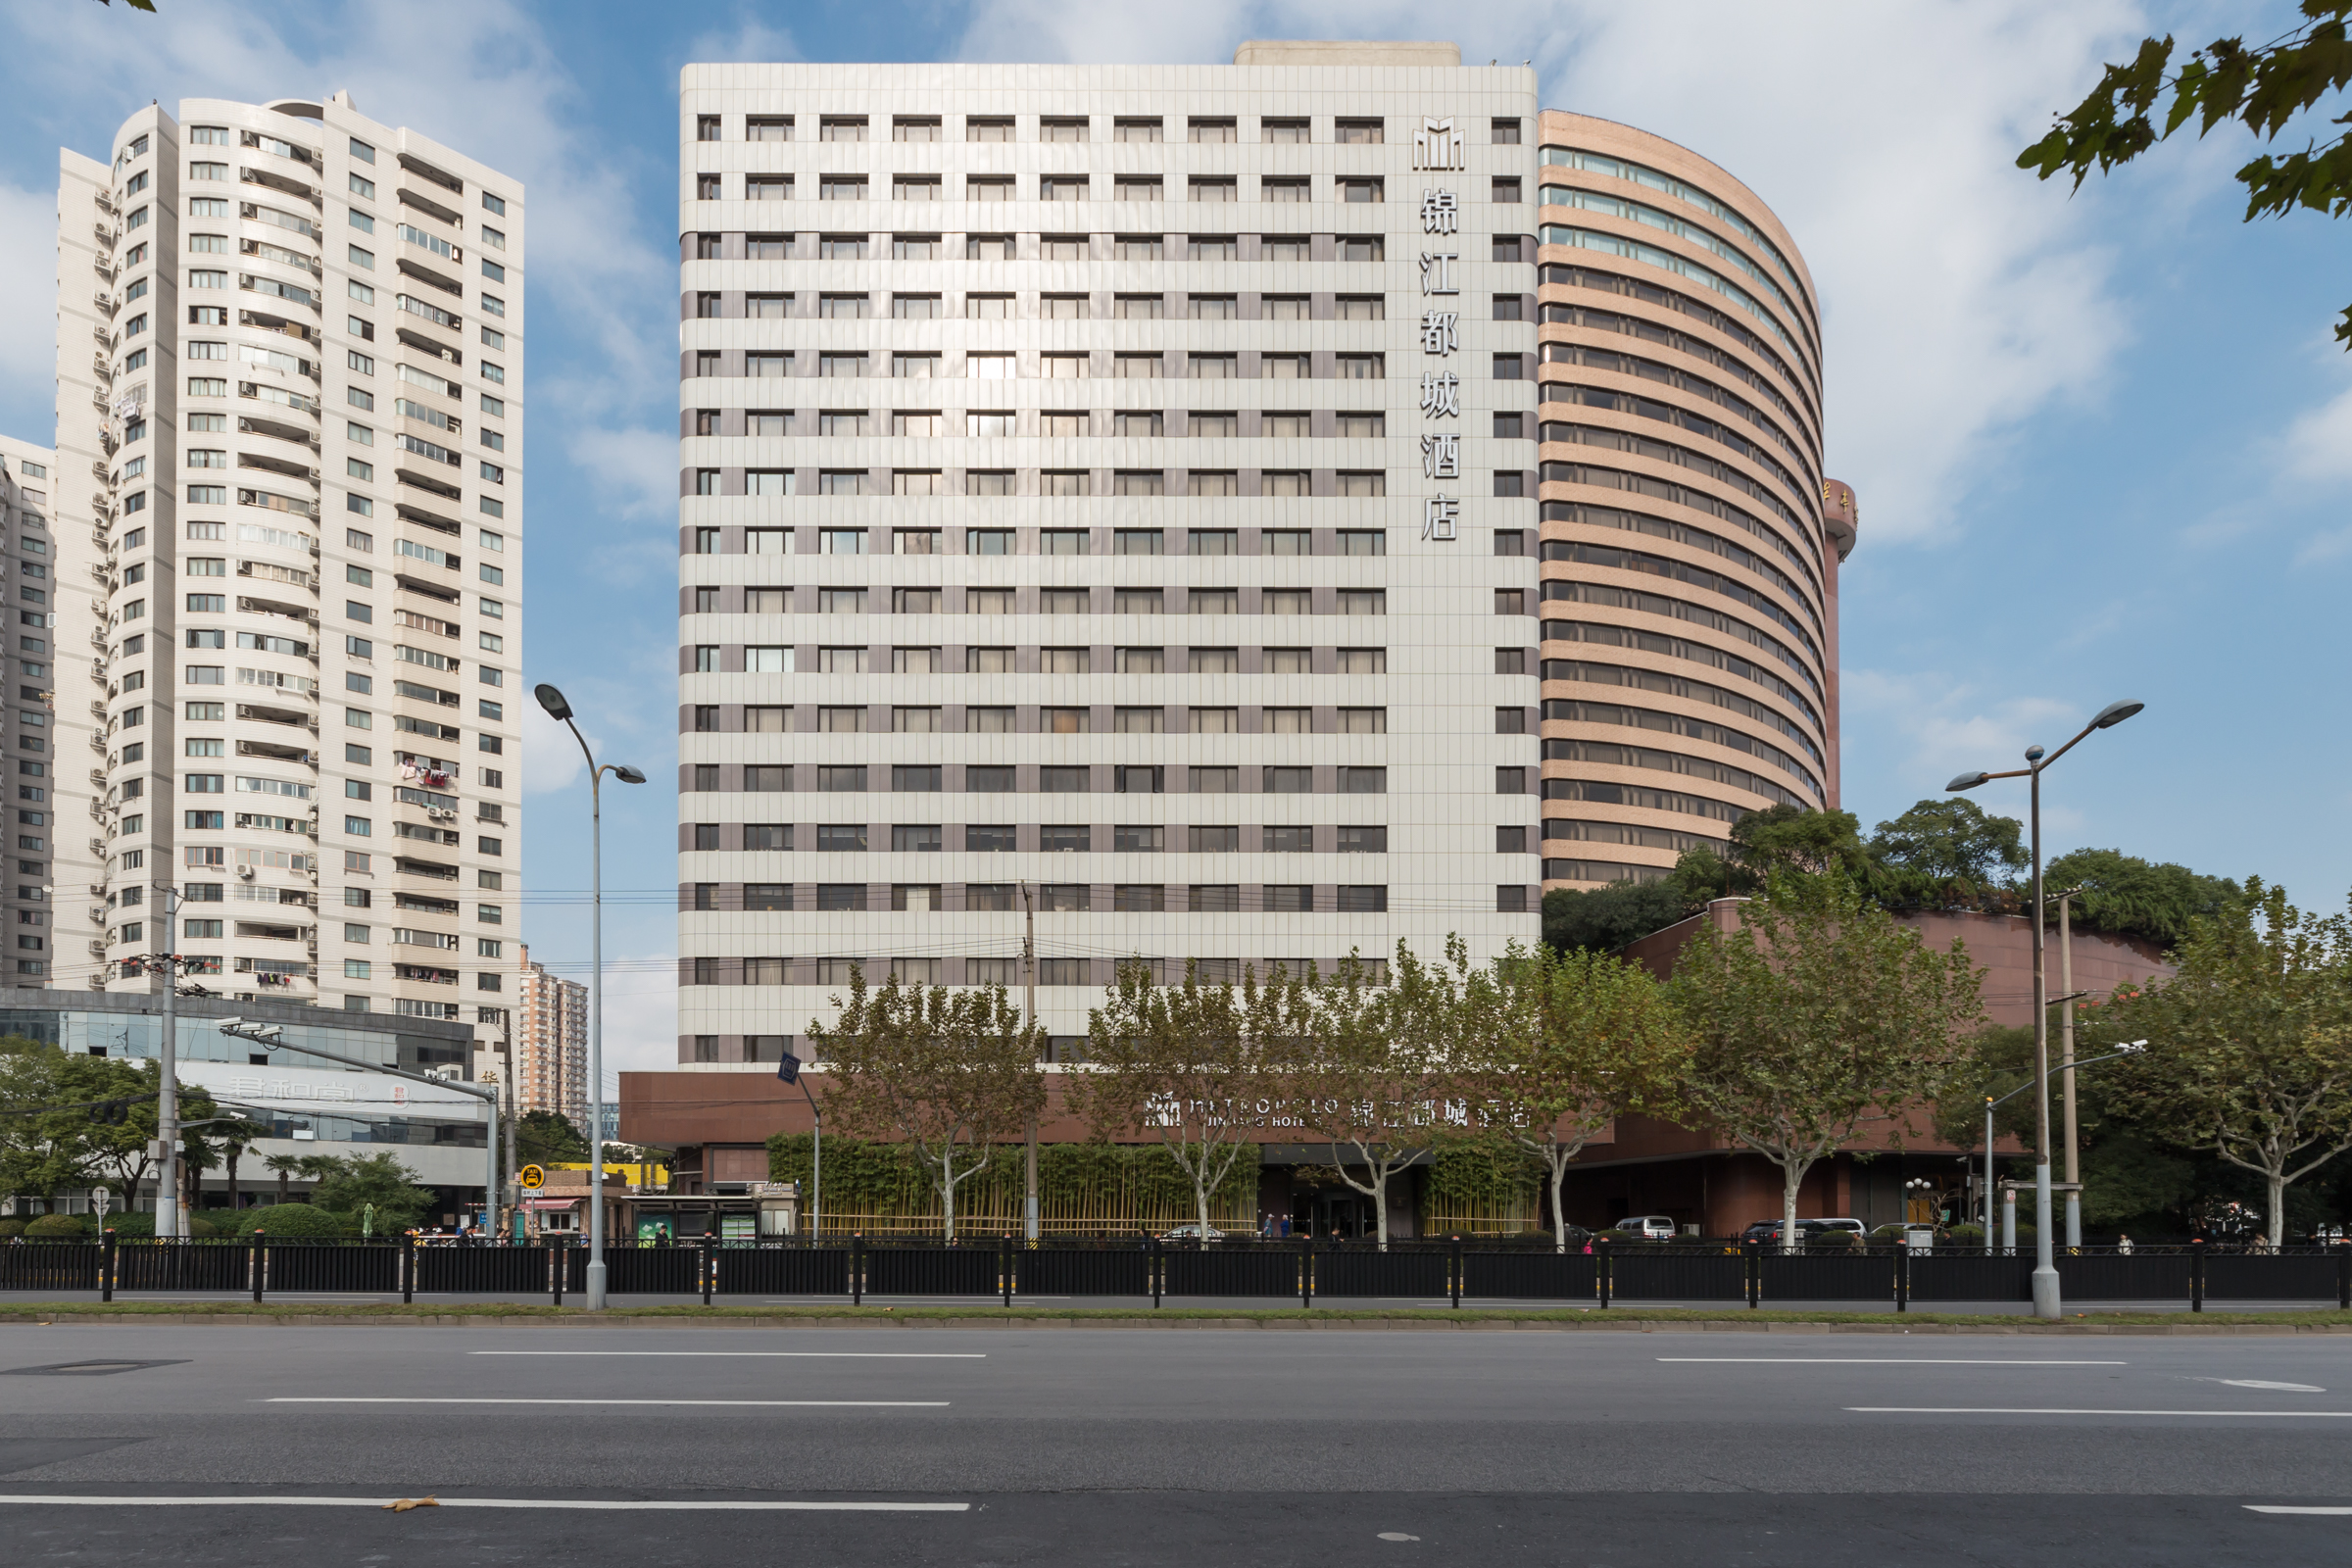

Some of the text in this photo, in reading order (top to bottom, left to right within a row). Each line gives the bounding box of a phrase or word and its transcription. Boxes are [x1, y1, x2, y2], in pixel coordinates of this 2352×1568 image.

[1419, 187, 1460, 541] 锦江都城酒店
[228, 1076, 354, 1105] 君和堂
[1272, 1116, 1321, 1127] HOTES
